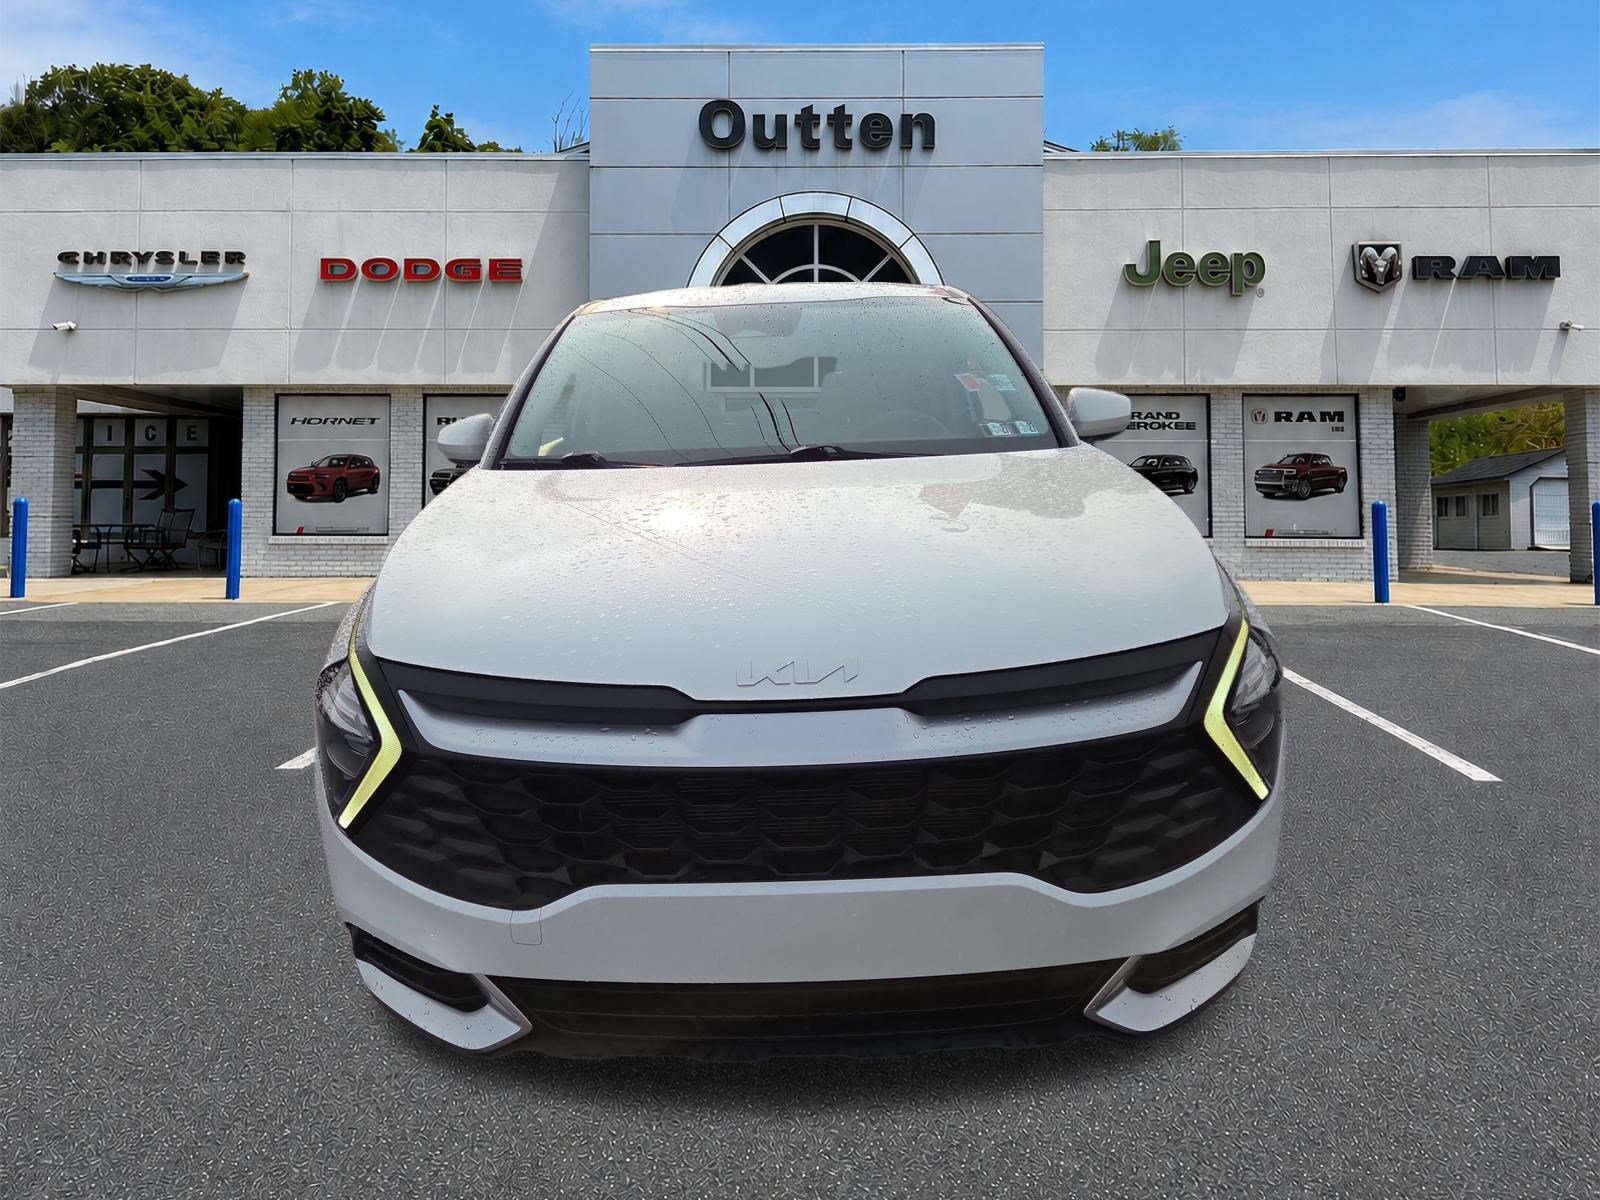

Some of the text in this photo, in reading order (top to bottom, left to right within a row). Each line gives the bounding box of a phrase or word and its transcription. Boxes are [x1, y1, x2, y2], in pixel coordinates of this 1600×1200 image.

[699, 99, 936, 150] Outten
[57, 251, 247, 265] CHRYSLER
[320, 257, 523, 282] DODGE
[1123, 239, 1266, 297] Jeep
[1411, 255, 1561, 280] RAM
[290, 417, 381, 425] HORNET
[1131, 411, 1180, 420] RAND
[1274, 411, 1344, 422] RAM
[1126, 421, 1197, 430] EROKEE
